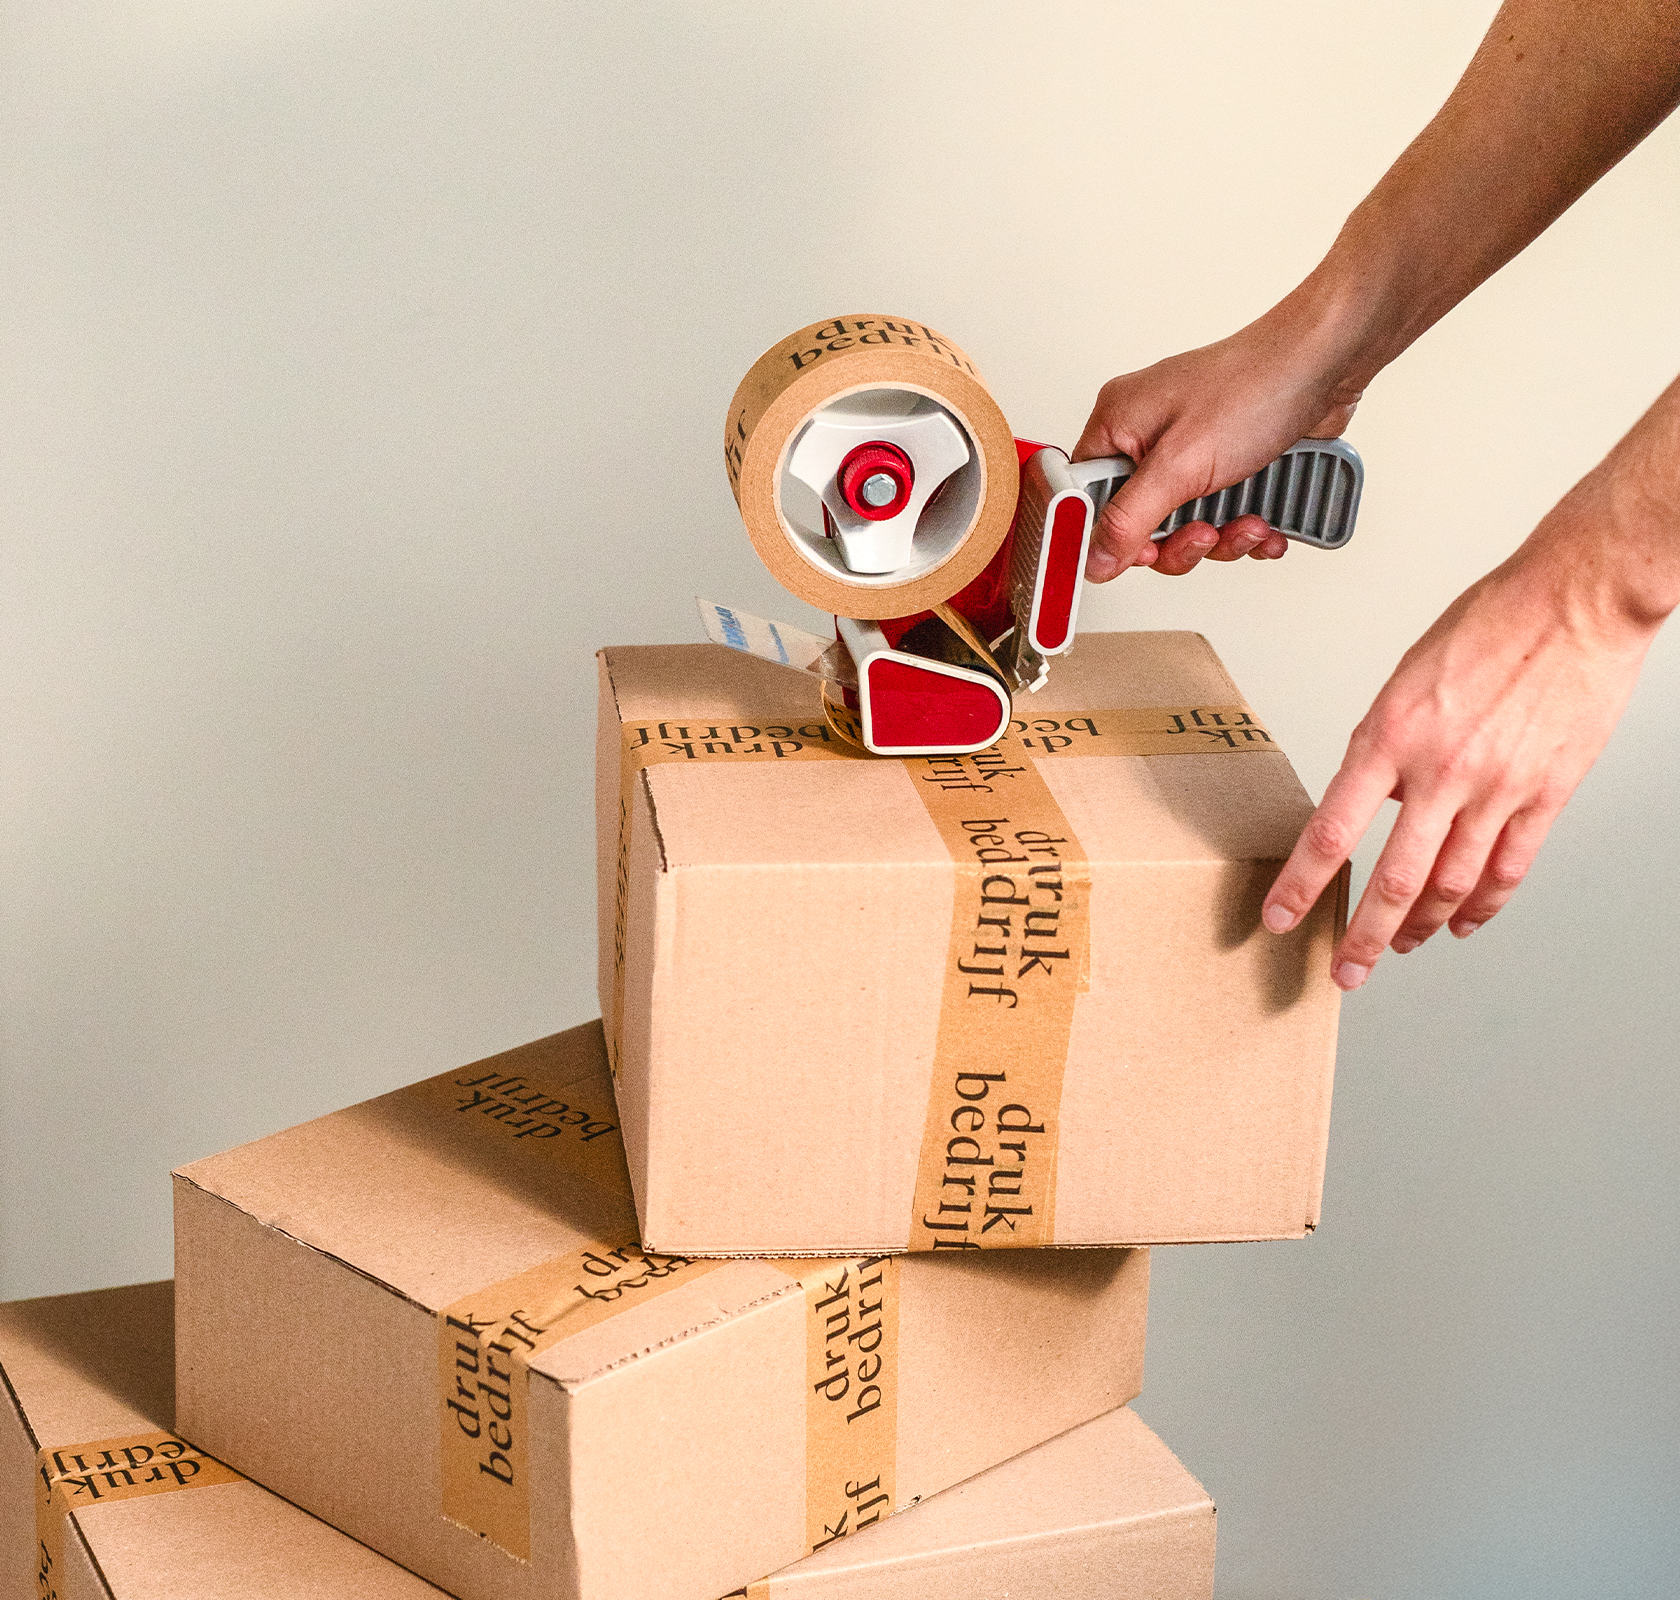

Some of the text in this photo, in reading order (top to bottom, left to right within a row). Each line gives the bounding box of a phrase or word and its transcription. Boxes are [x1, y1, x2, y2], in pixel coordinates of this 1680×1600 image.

[815, 320, 954, 352] druk
[630, 721, 836, 750] bedrijf
[1166, 709, 1255, 734] rijf
[1198, 729, 1274, 748] uk
[661, 740, 803, 759] druk
[454, 1072, 619, 1142] bedrijf
[456, 1090, 562, 1139] druk
[981, 1103, 1045, 1234] druk
[814, 1266, 850, 1402] druk
[846, 1255, 893, 1425] bedrij
[446, 1312, 499, 1439] druk
[477, 1309, 548, 1487] bedrijf
[61, 1459, 201, 1499] druk
